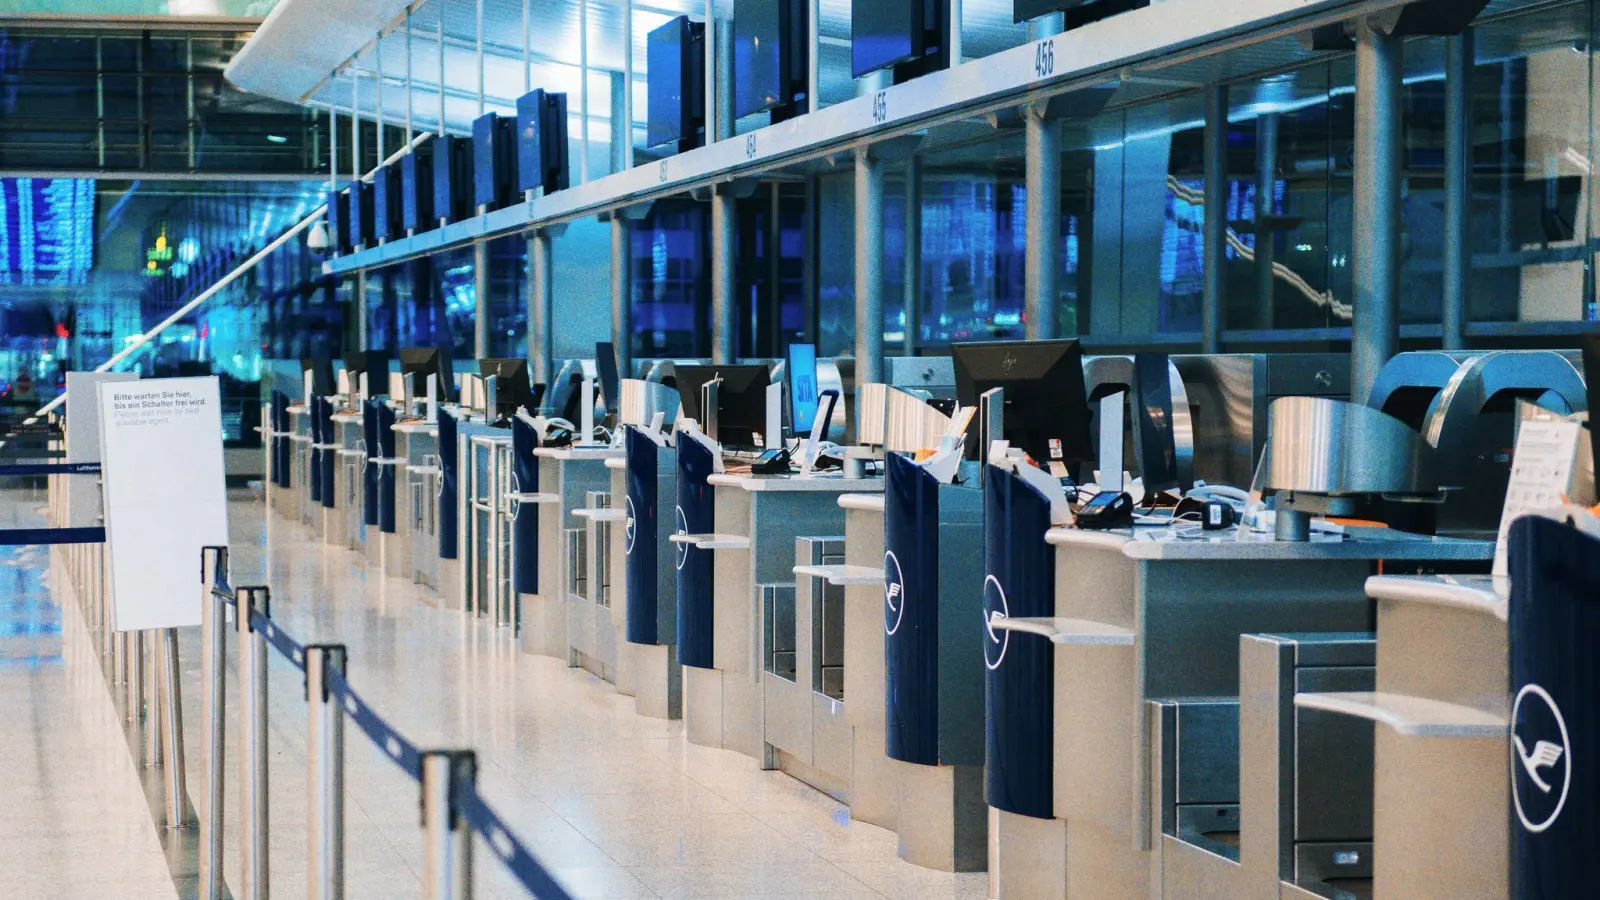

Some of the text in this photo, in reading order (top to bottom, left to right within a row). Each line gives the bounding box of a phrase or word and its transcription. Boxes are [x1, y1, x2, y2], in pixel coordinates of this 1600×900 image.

[1035, 39, 1054, 77] 456
[872, 91, 887, 122] 455
[113, 393, 133, 401] Bitte
[134, 392, 160, 400] warten
[161, 391, 175, 399] Sie
[114, 402, 127, 410] bis
[141, 400, 173, 408] Schalter
[175, 398, 188, 407] frei
